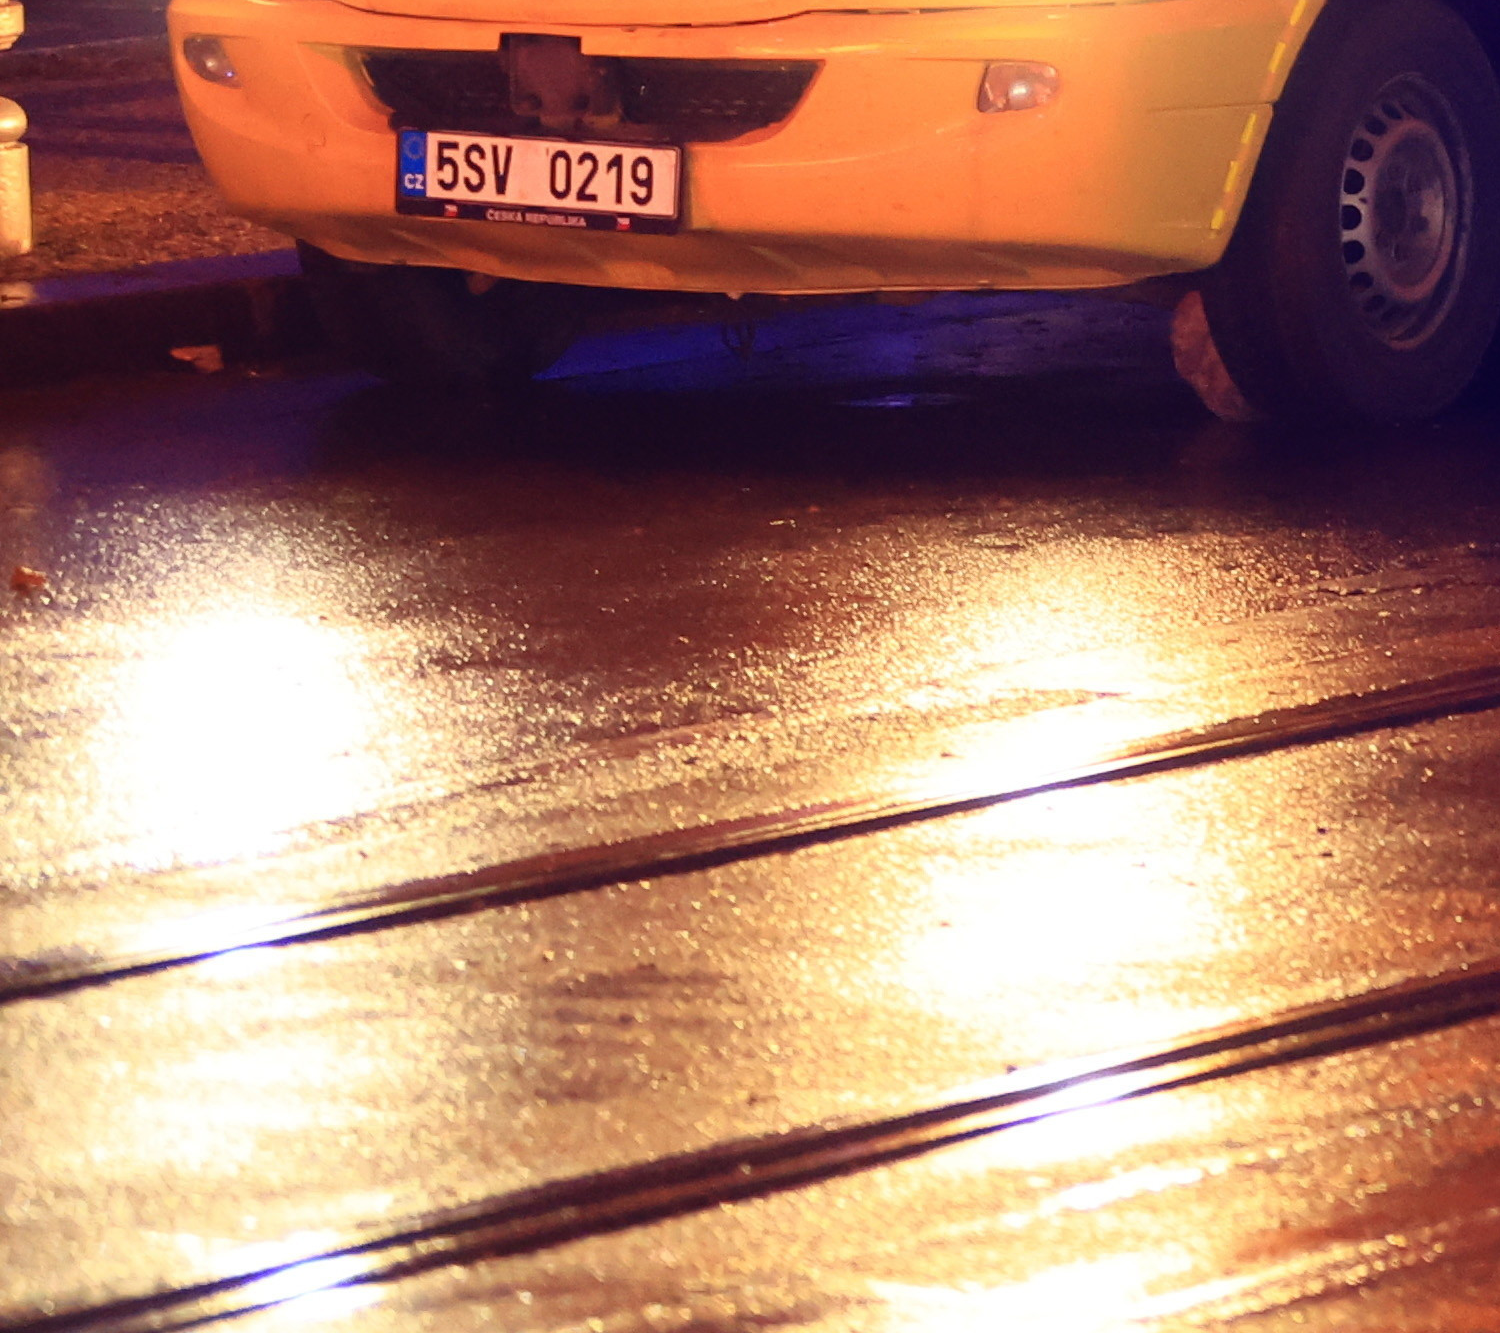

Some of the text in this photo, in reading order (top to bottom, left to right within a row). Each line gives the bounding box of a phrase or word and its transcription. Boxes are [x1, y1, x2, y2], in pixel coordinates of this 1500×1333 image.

[404, 173, 424, 190] CZ
[436, 140, 654, 206] 5SV 0219
